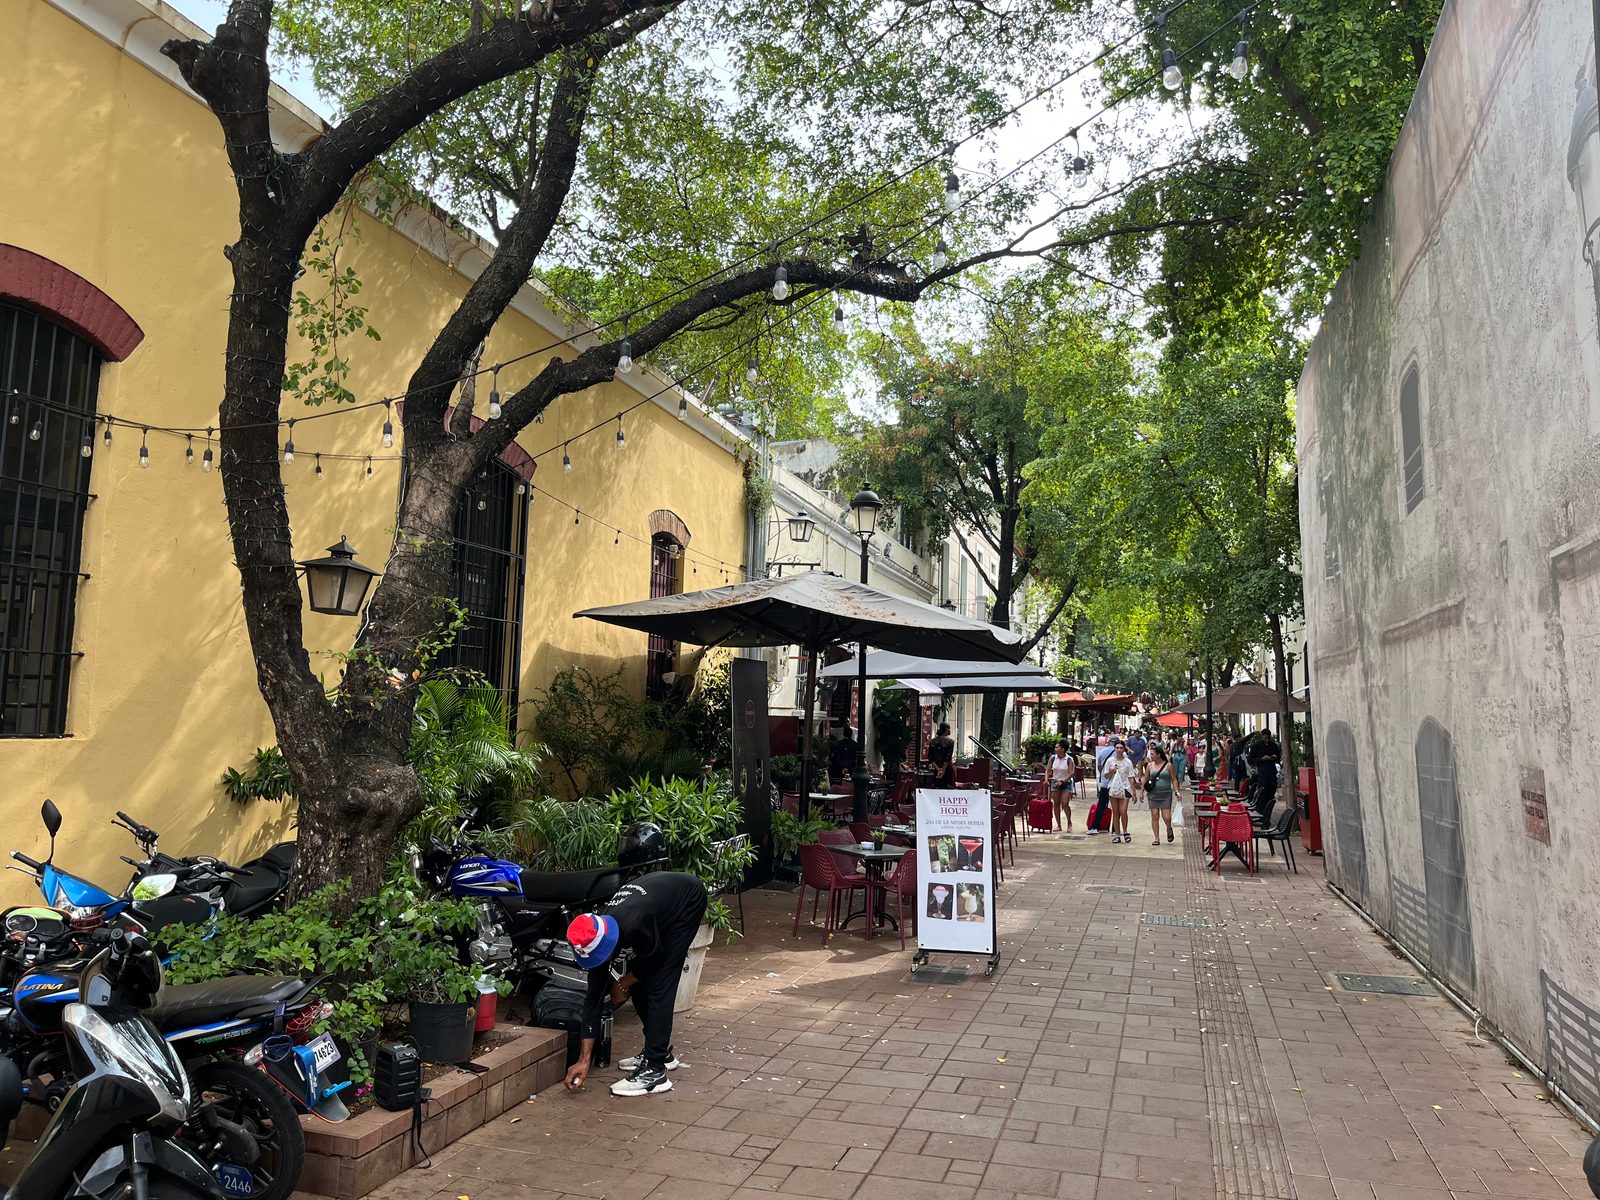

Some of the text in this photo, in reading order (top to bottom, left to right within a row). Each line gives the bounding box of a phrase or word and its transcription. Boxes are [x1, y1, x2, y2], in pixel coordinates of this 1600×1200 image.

[941, 807, 968, 815] HOUR
[18, 983, 63, 991] PLATINA
[314, 1042, 334, 1062] 74623
[224, 1175, 251, 1193] 2446
